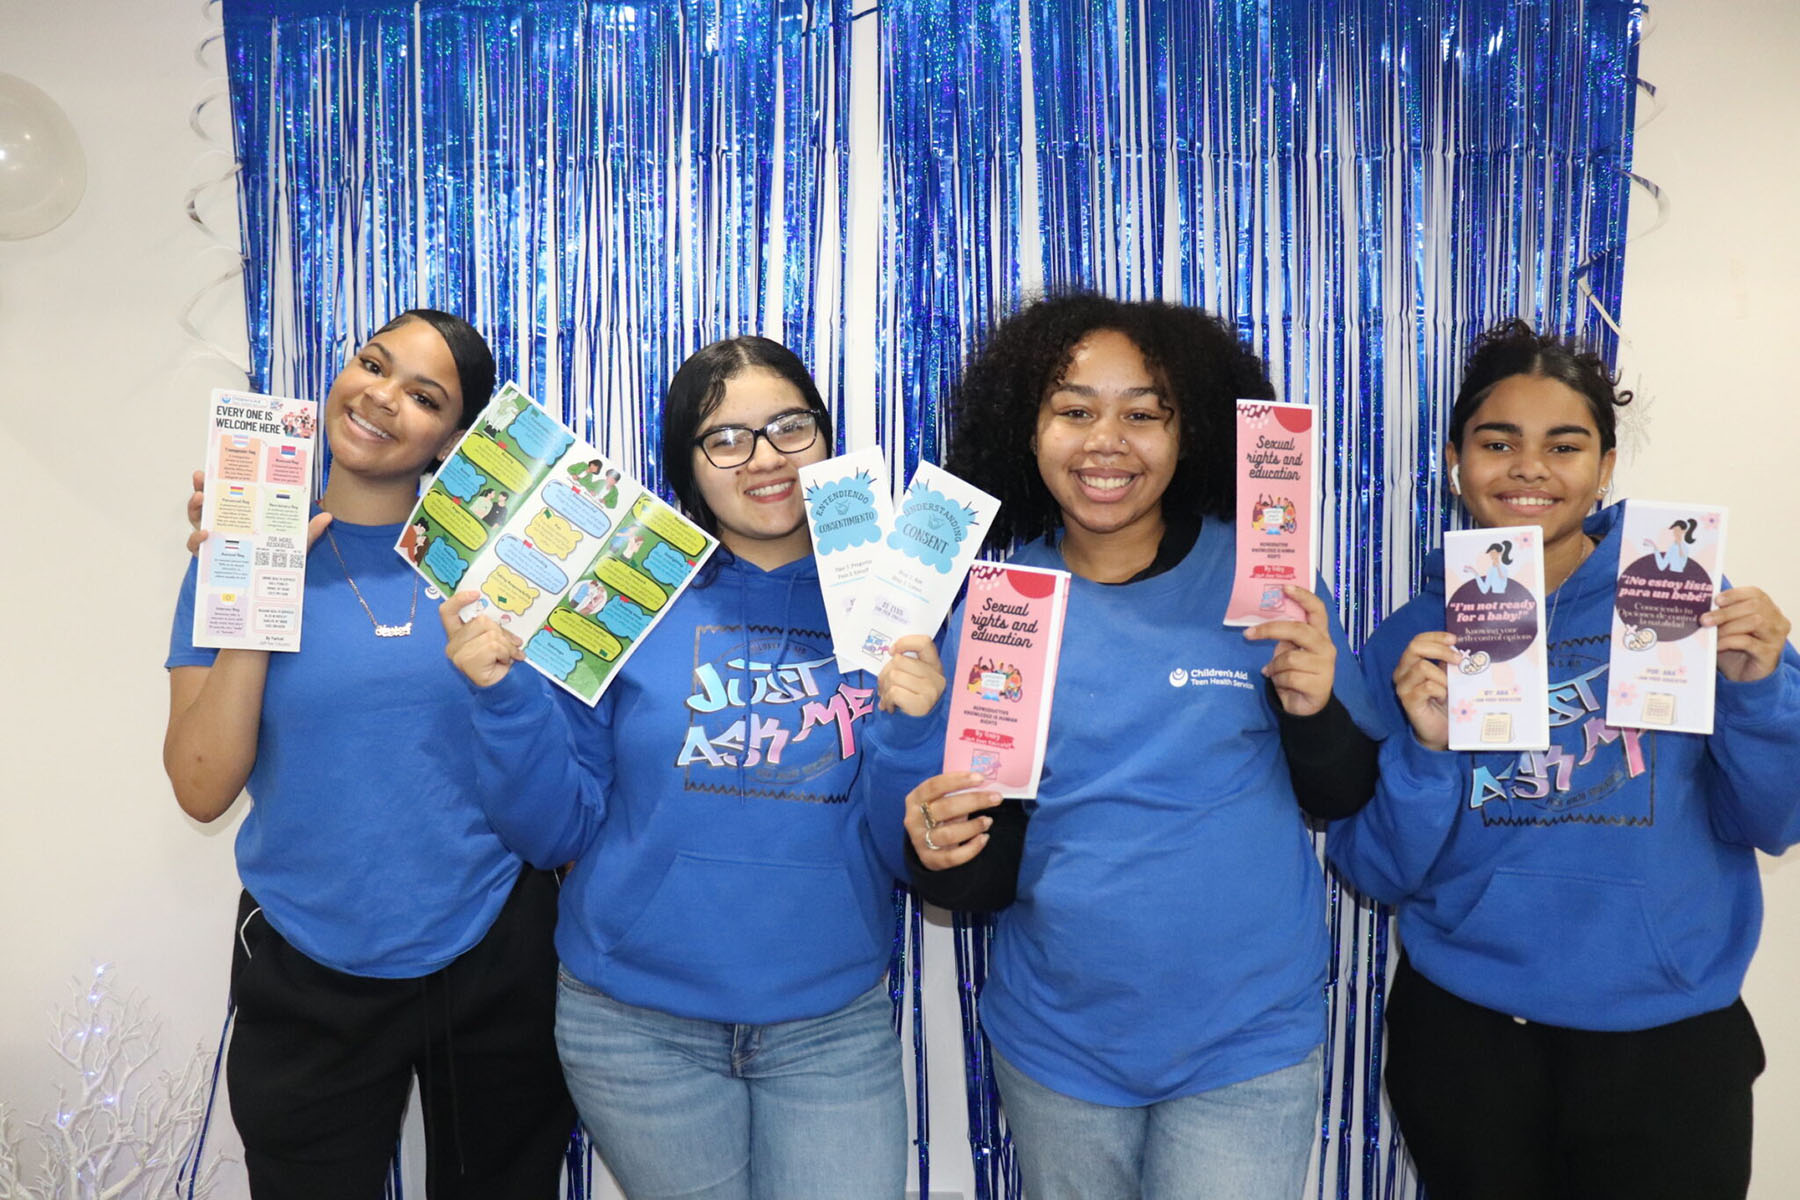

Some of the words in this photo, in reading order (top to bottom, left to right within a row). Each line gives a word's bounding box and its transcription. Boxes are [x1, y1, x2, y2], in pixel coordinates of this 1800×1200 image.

[216, 406, 244, 418] EVERY
[246, 409, 263, 420] ONE
[264, 412, 272, 421] IS
[216, 418, 258, 432] WELCOME
[259, 423, 281, 434] HERE
[1256, 435, 1296, 450] Sexual
[1246, 450, 1281, 469] rights
[1282, 452, 1304, 466] and
[1248, 466, 1301, 481] education
[816, 489, 870, 517] ENTENDIENDO
[818, 511, 876, 534] CONSENTIMIENTO
[904, 502, 962, 544] UNDERSTANDING
[902, 522, 950, 555] CONSENT
[1618, 588, 1650, 598] para
[1652, 590, 1670, 600] un
[1648, 578, 1684, 590] estoy
[1684, 580, 1713, 591] lista
[982, 597, 1030, 616] Sexual
[1477, 602, 1498, 610] not
[1500, 600, 1536, 612] ready
[971, 612, 1008, 631] rights
[1012, 620, 1038, 633] and
[1456, 612, 1476, 622] for
[971, 628, 1032, 648] education
[1190, 668, 1233, 678] Children's
[1234, 671, 1248, 680] Aid
[1190, 678, 1208, 686] Teen
[686, 656, 836, 712] JUST
[1548, 664, 1609, 726] ST
[792, 683, 874, 760] ME
[676, 713, 790, 767] ASK
[1578, 717, 1646, 778] M
